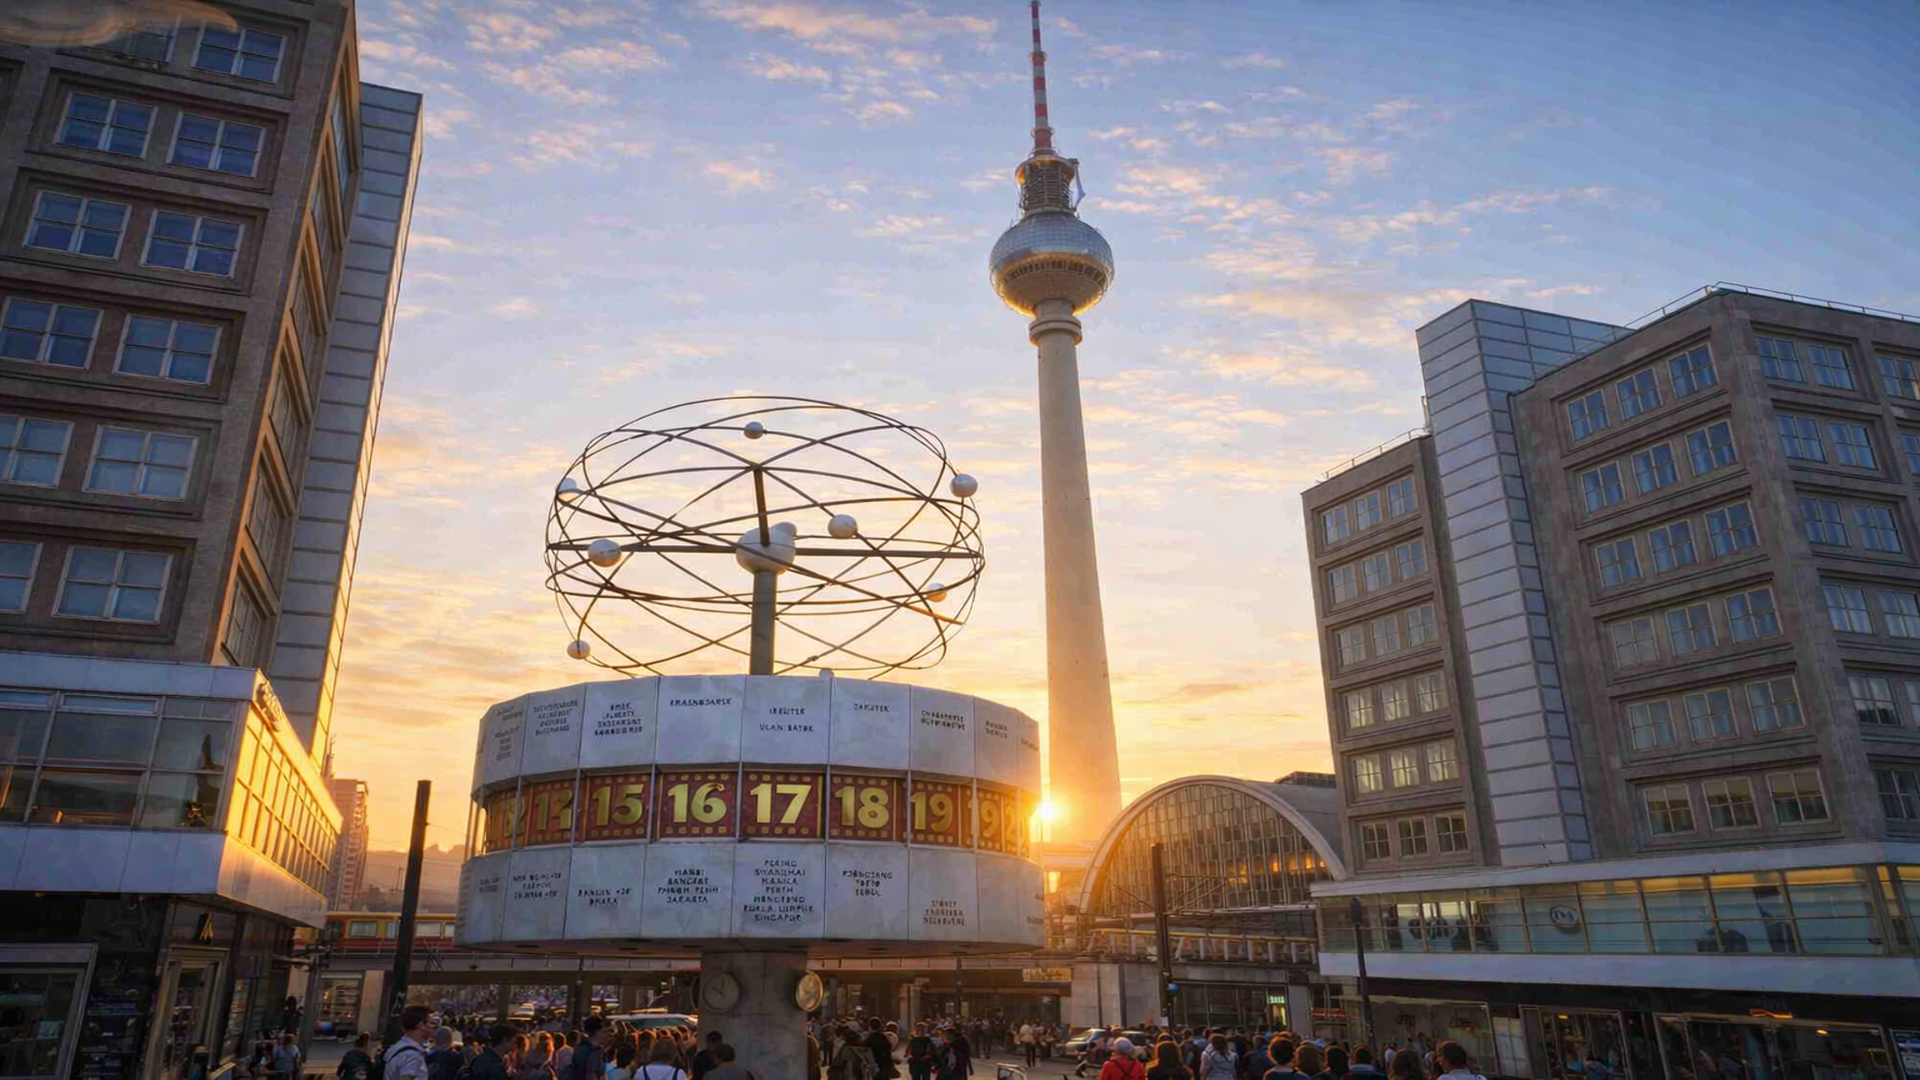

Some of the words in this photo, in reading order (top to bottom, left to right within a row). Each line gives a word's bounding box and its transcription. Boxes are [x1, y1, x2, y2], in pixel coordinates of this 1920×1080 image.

[592, 783, 645, 827] 15
[667, 782, 728, 825] 16
[750, 783, 812, 824] 17
[834, 786, 890, 828] 18
[909, 791, 954, 832] 19
